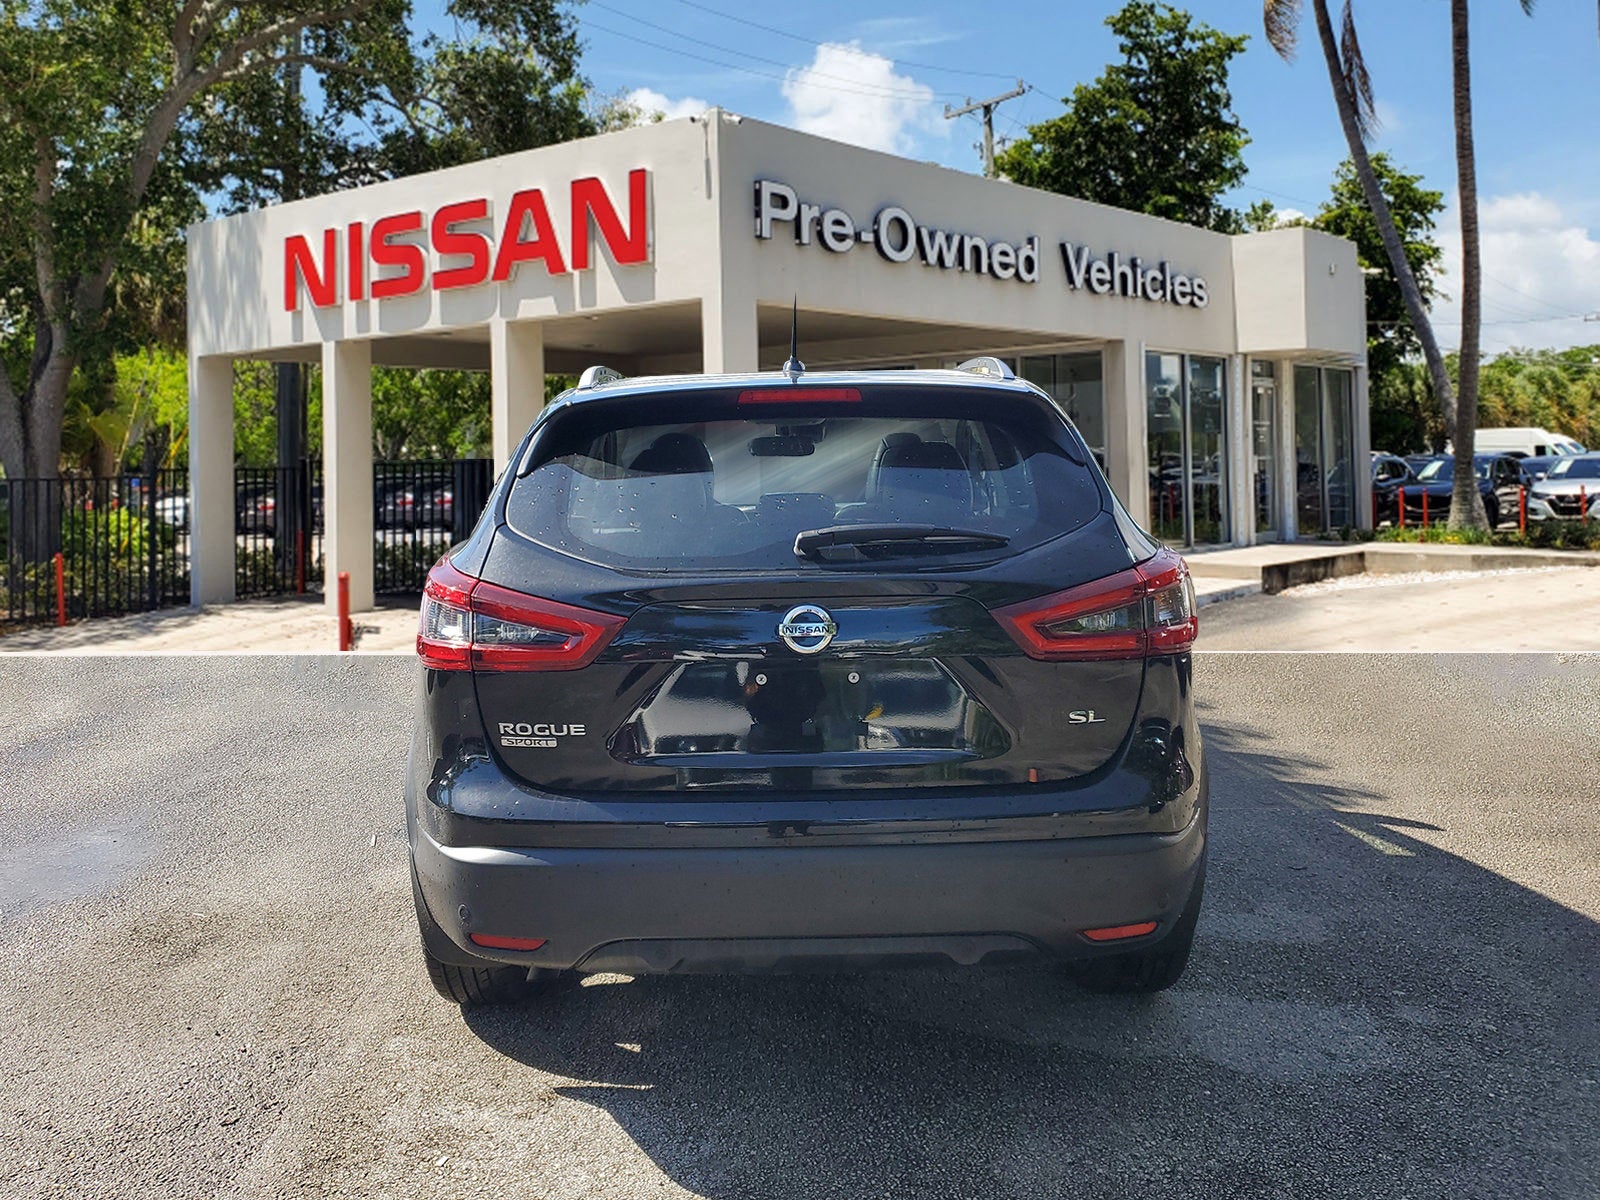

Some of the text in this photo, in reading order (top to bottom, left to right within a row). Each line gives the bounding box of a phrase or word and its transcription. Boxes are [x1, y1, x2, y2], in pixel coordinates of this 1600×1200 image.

[284, 168, 648, 312] NISSAN
[754, 179, 1209, 308] Pre-Owned Vehicles
[784, 625, 830, 635] NISSAN
[1068, 710, 1106, 724] SL
[498, 722, 587, 736] ROGUE
[505, 738, 551, 747] SPORT
